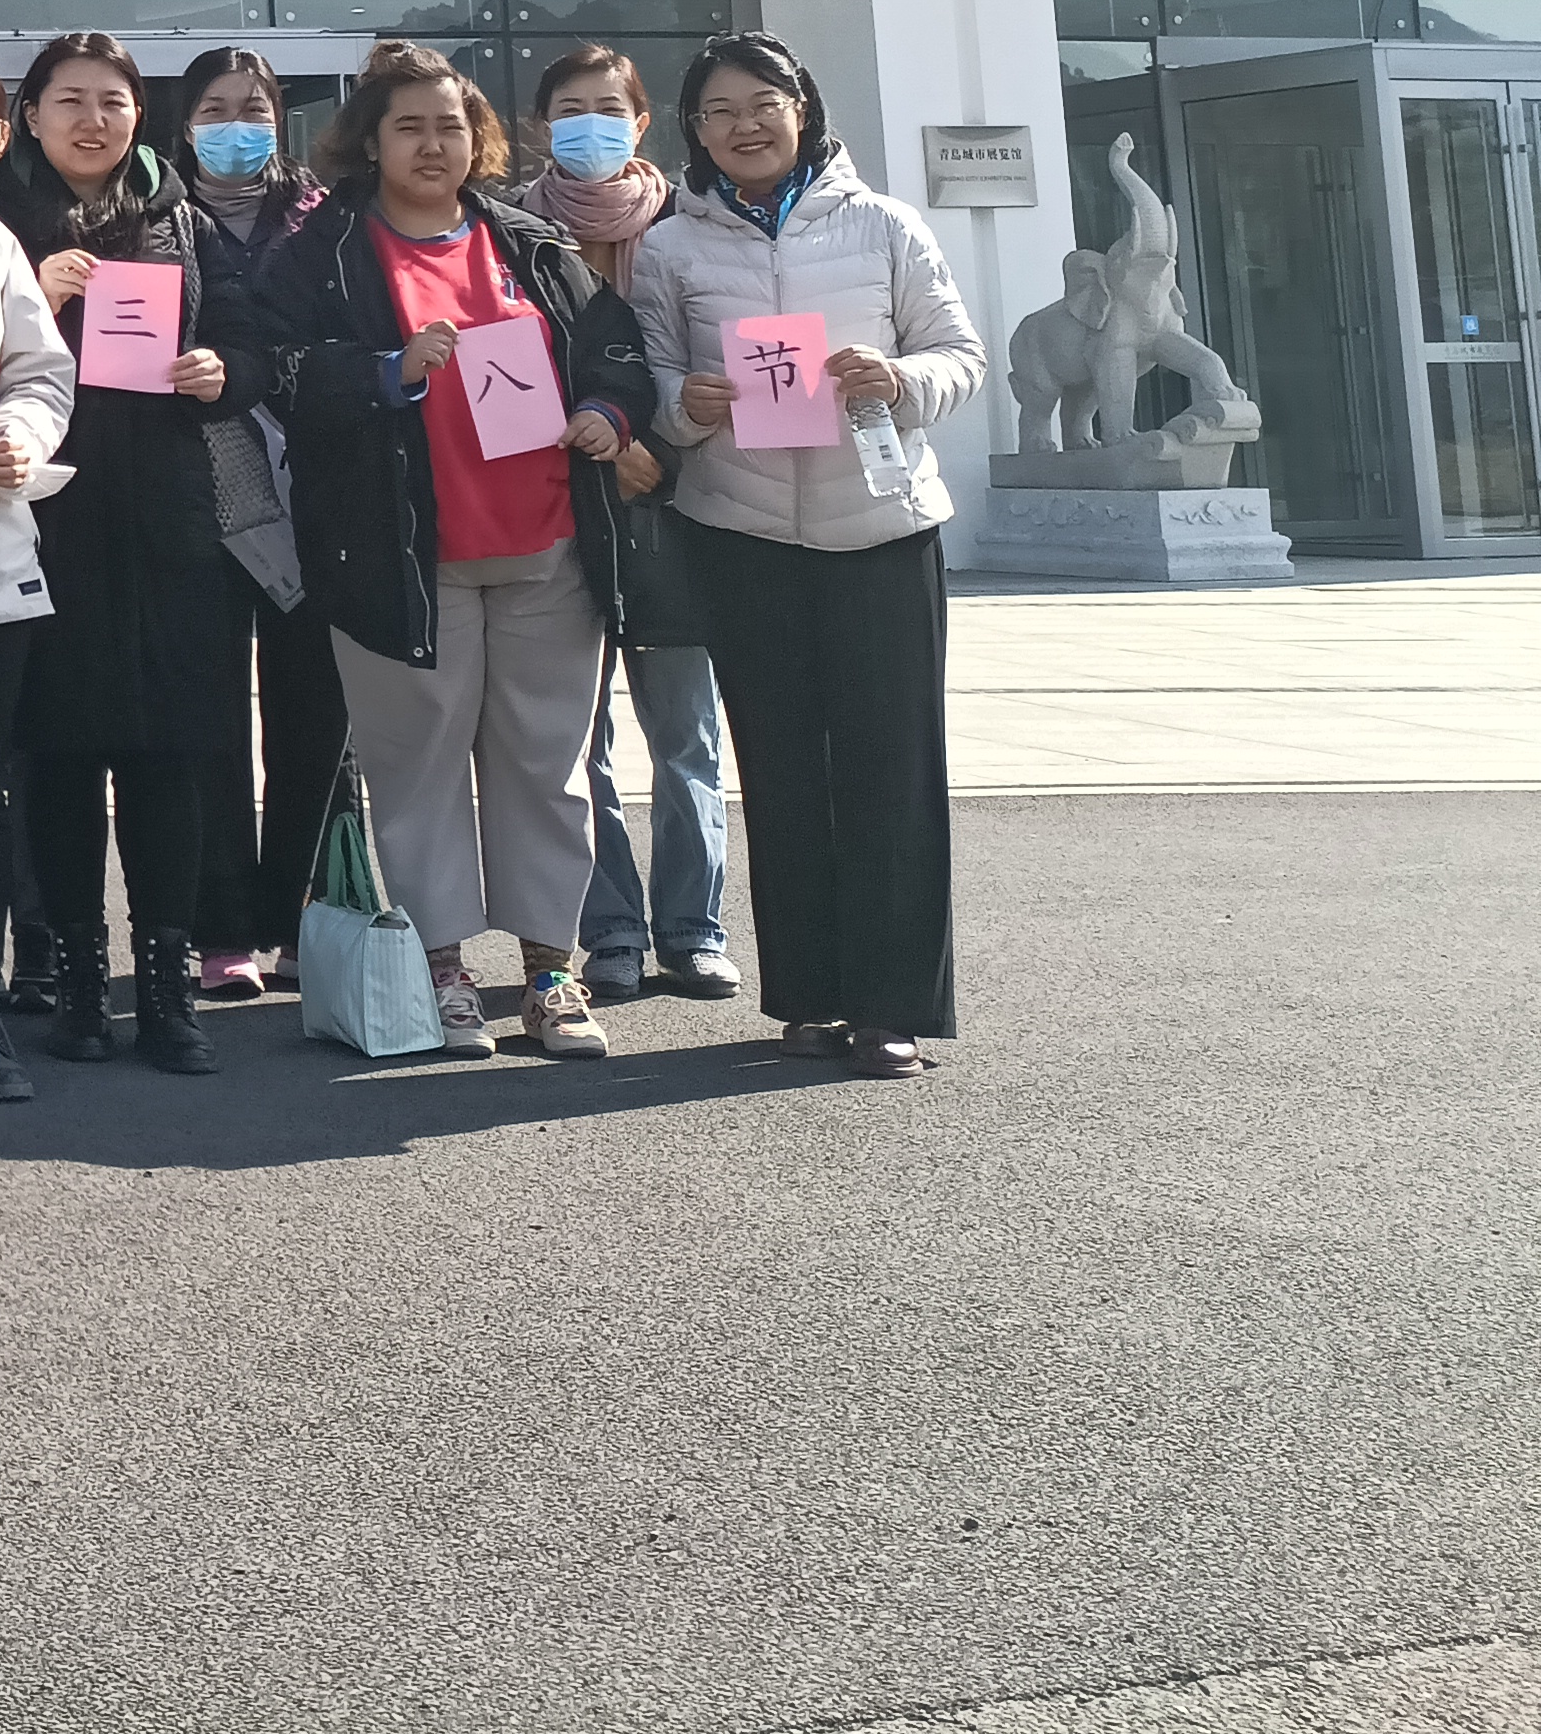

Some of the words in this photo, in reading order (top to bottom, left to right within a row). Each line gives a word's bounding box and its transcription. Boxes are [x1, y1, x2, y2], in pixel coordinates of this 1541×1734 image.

[98, 298, 158, 339] 三
[476, 360, 536, 404] 八
[742, 340, 802, 404] 节
